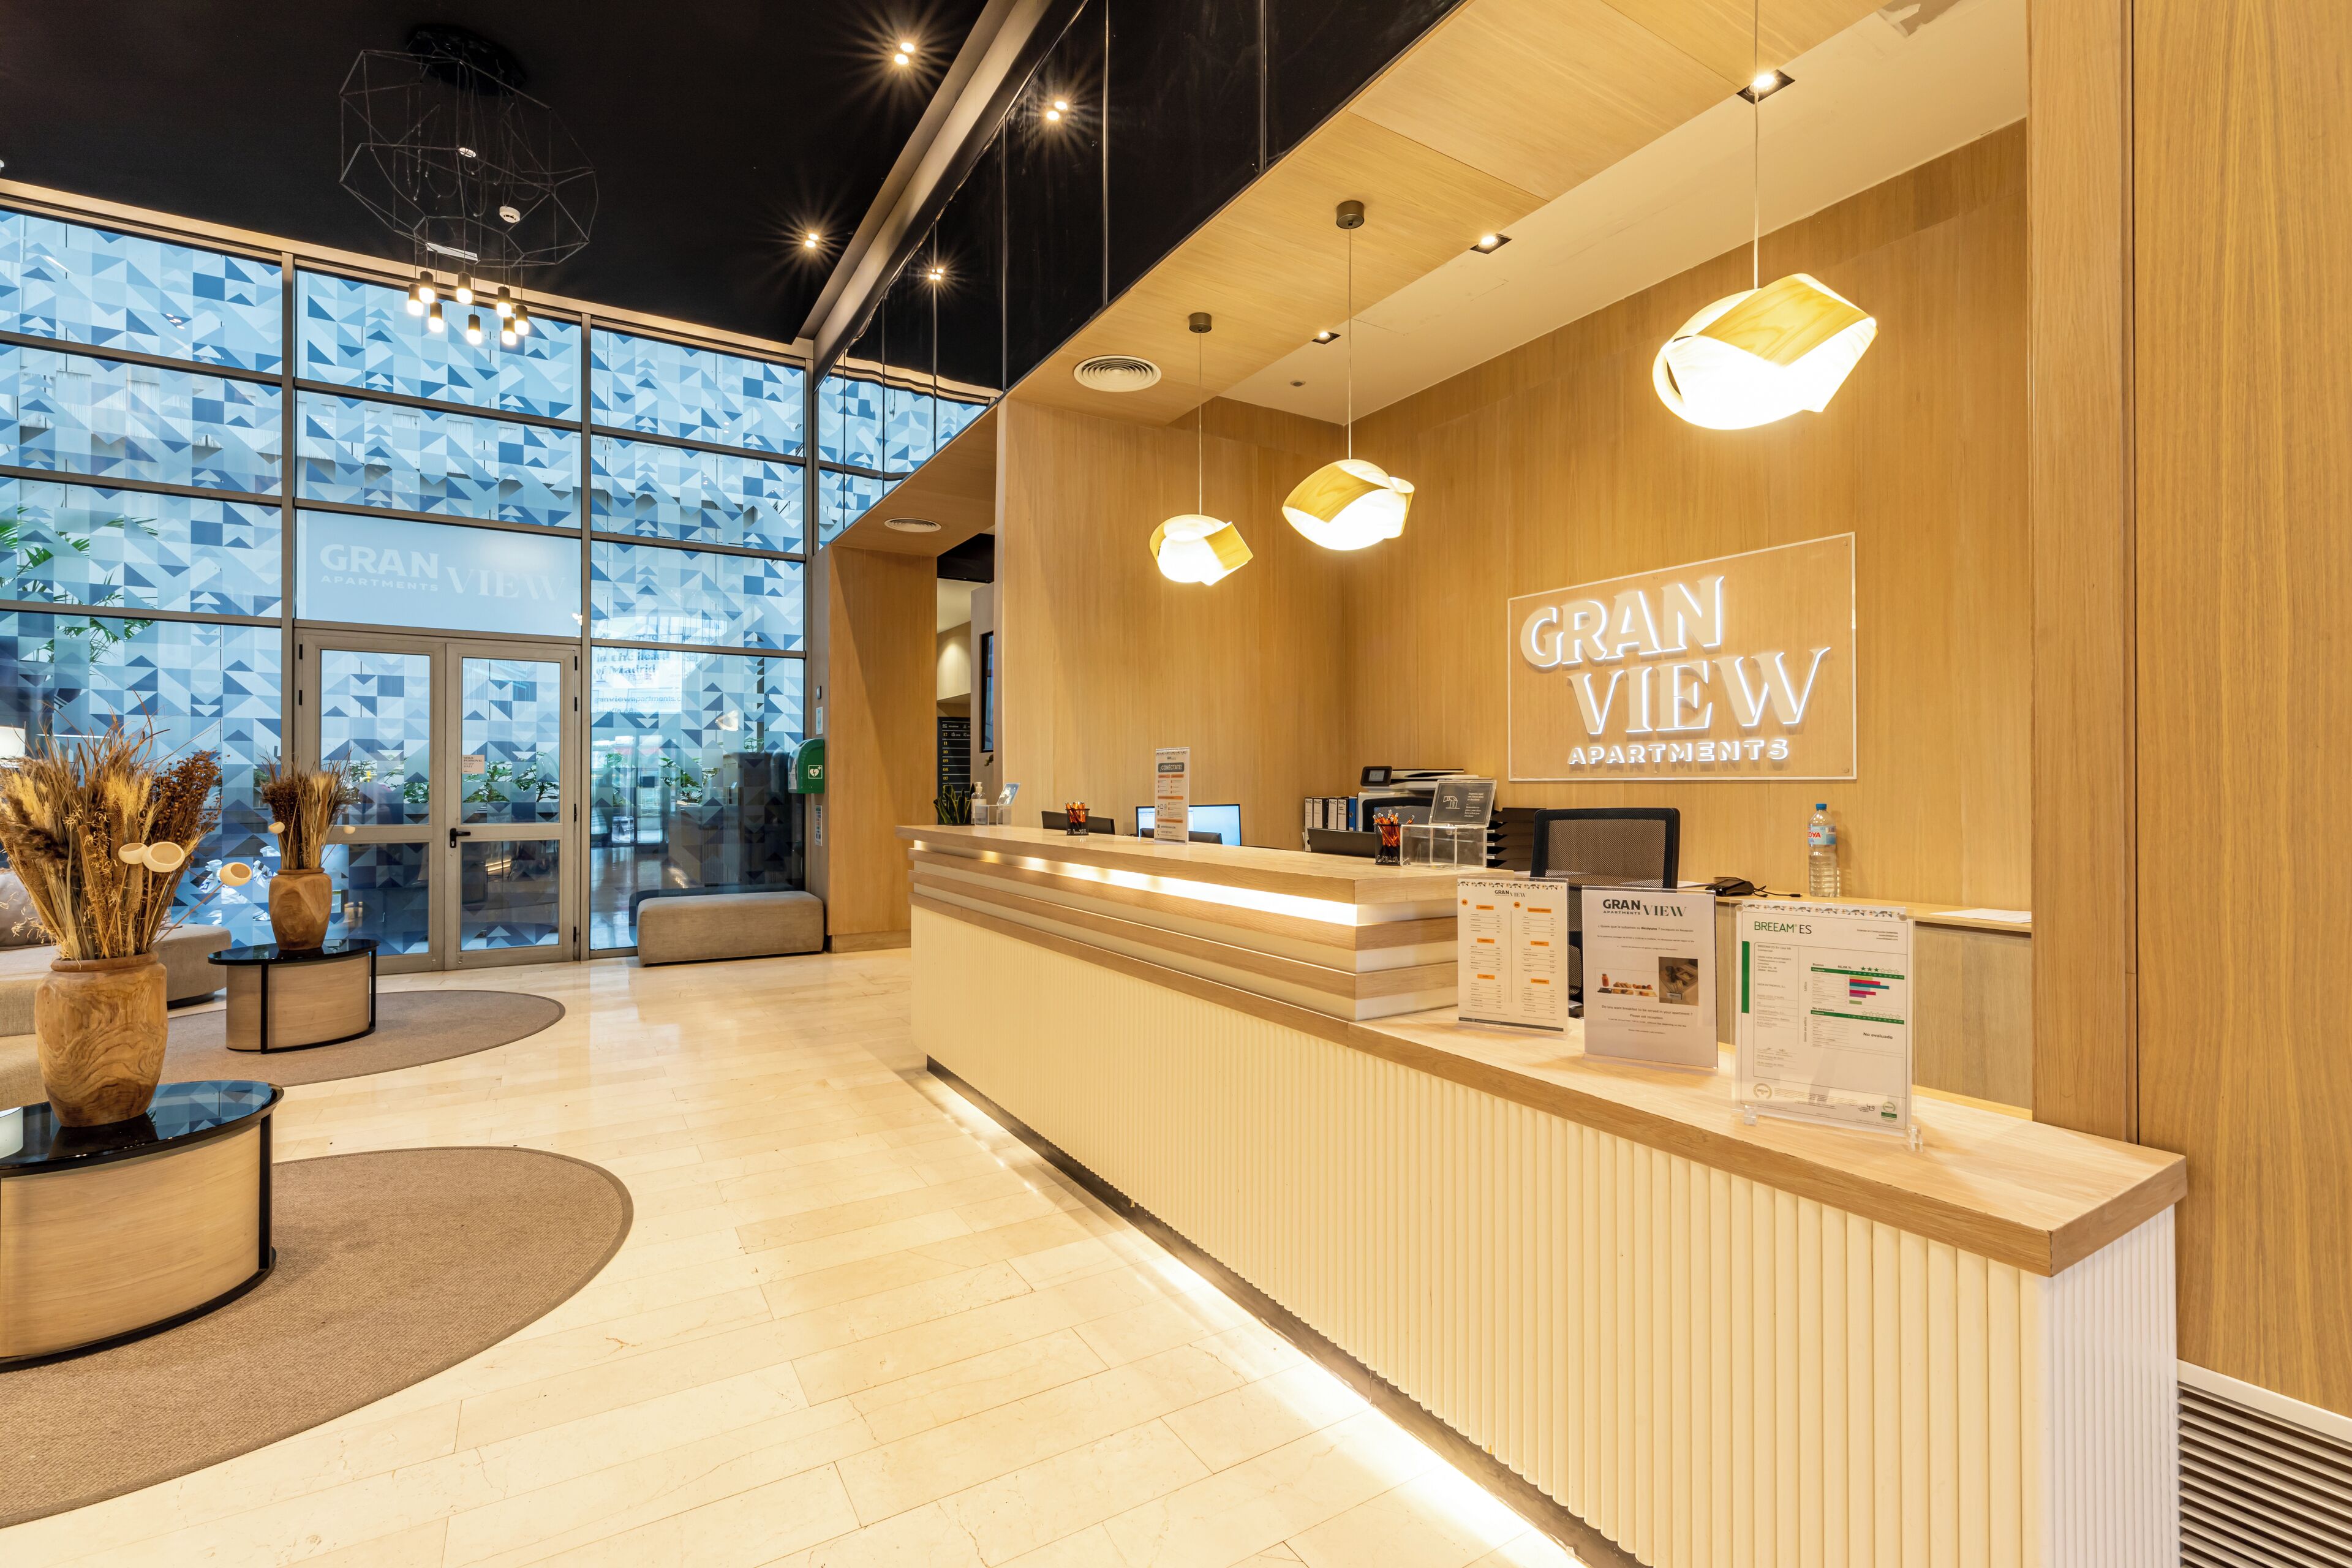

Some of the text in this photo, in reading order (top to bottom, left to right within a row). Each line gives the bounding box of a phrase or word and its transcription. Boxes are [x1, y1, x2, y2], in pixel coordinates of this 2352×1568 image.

[320, 543, 567, 601] GRAN VIEW
[321, 575, 438, 592] APARTMENTS
[1520, 575, 1725, 668] GRAN
[609, 663, 656, 674] Madrid
[1566, 646, 1831, 735] VIEW
[1567, 739, 1789, 765] APARTMENTS
[1602, 899, 1687, 917] GRAN VIEW
[1799, 924, 1812, 935] ES
